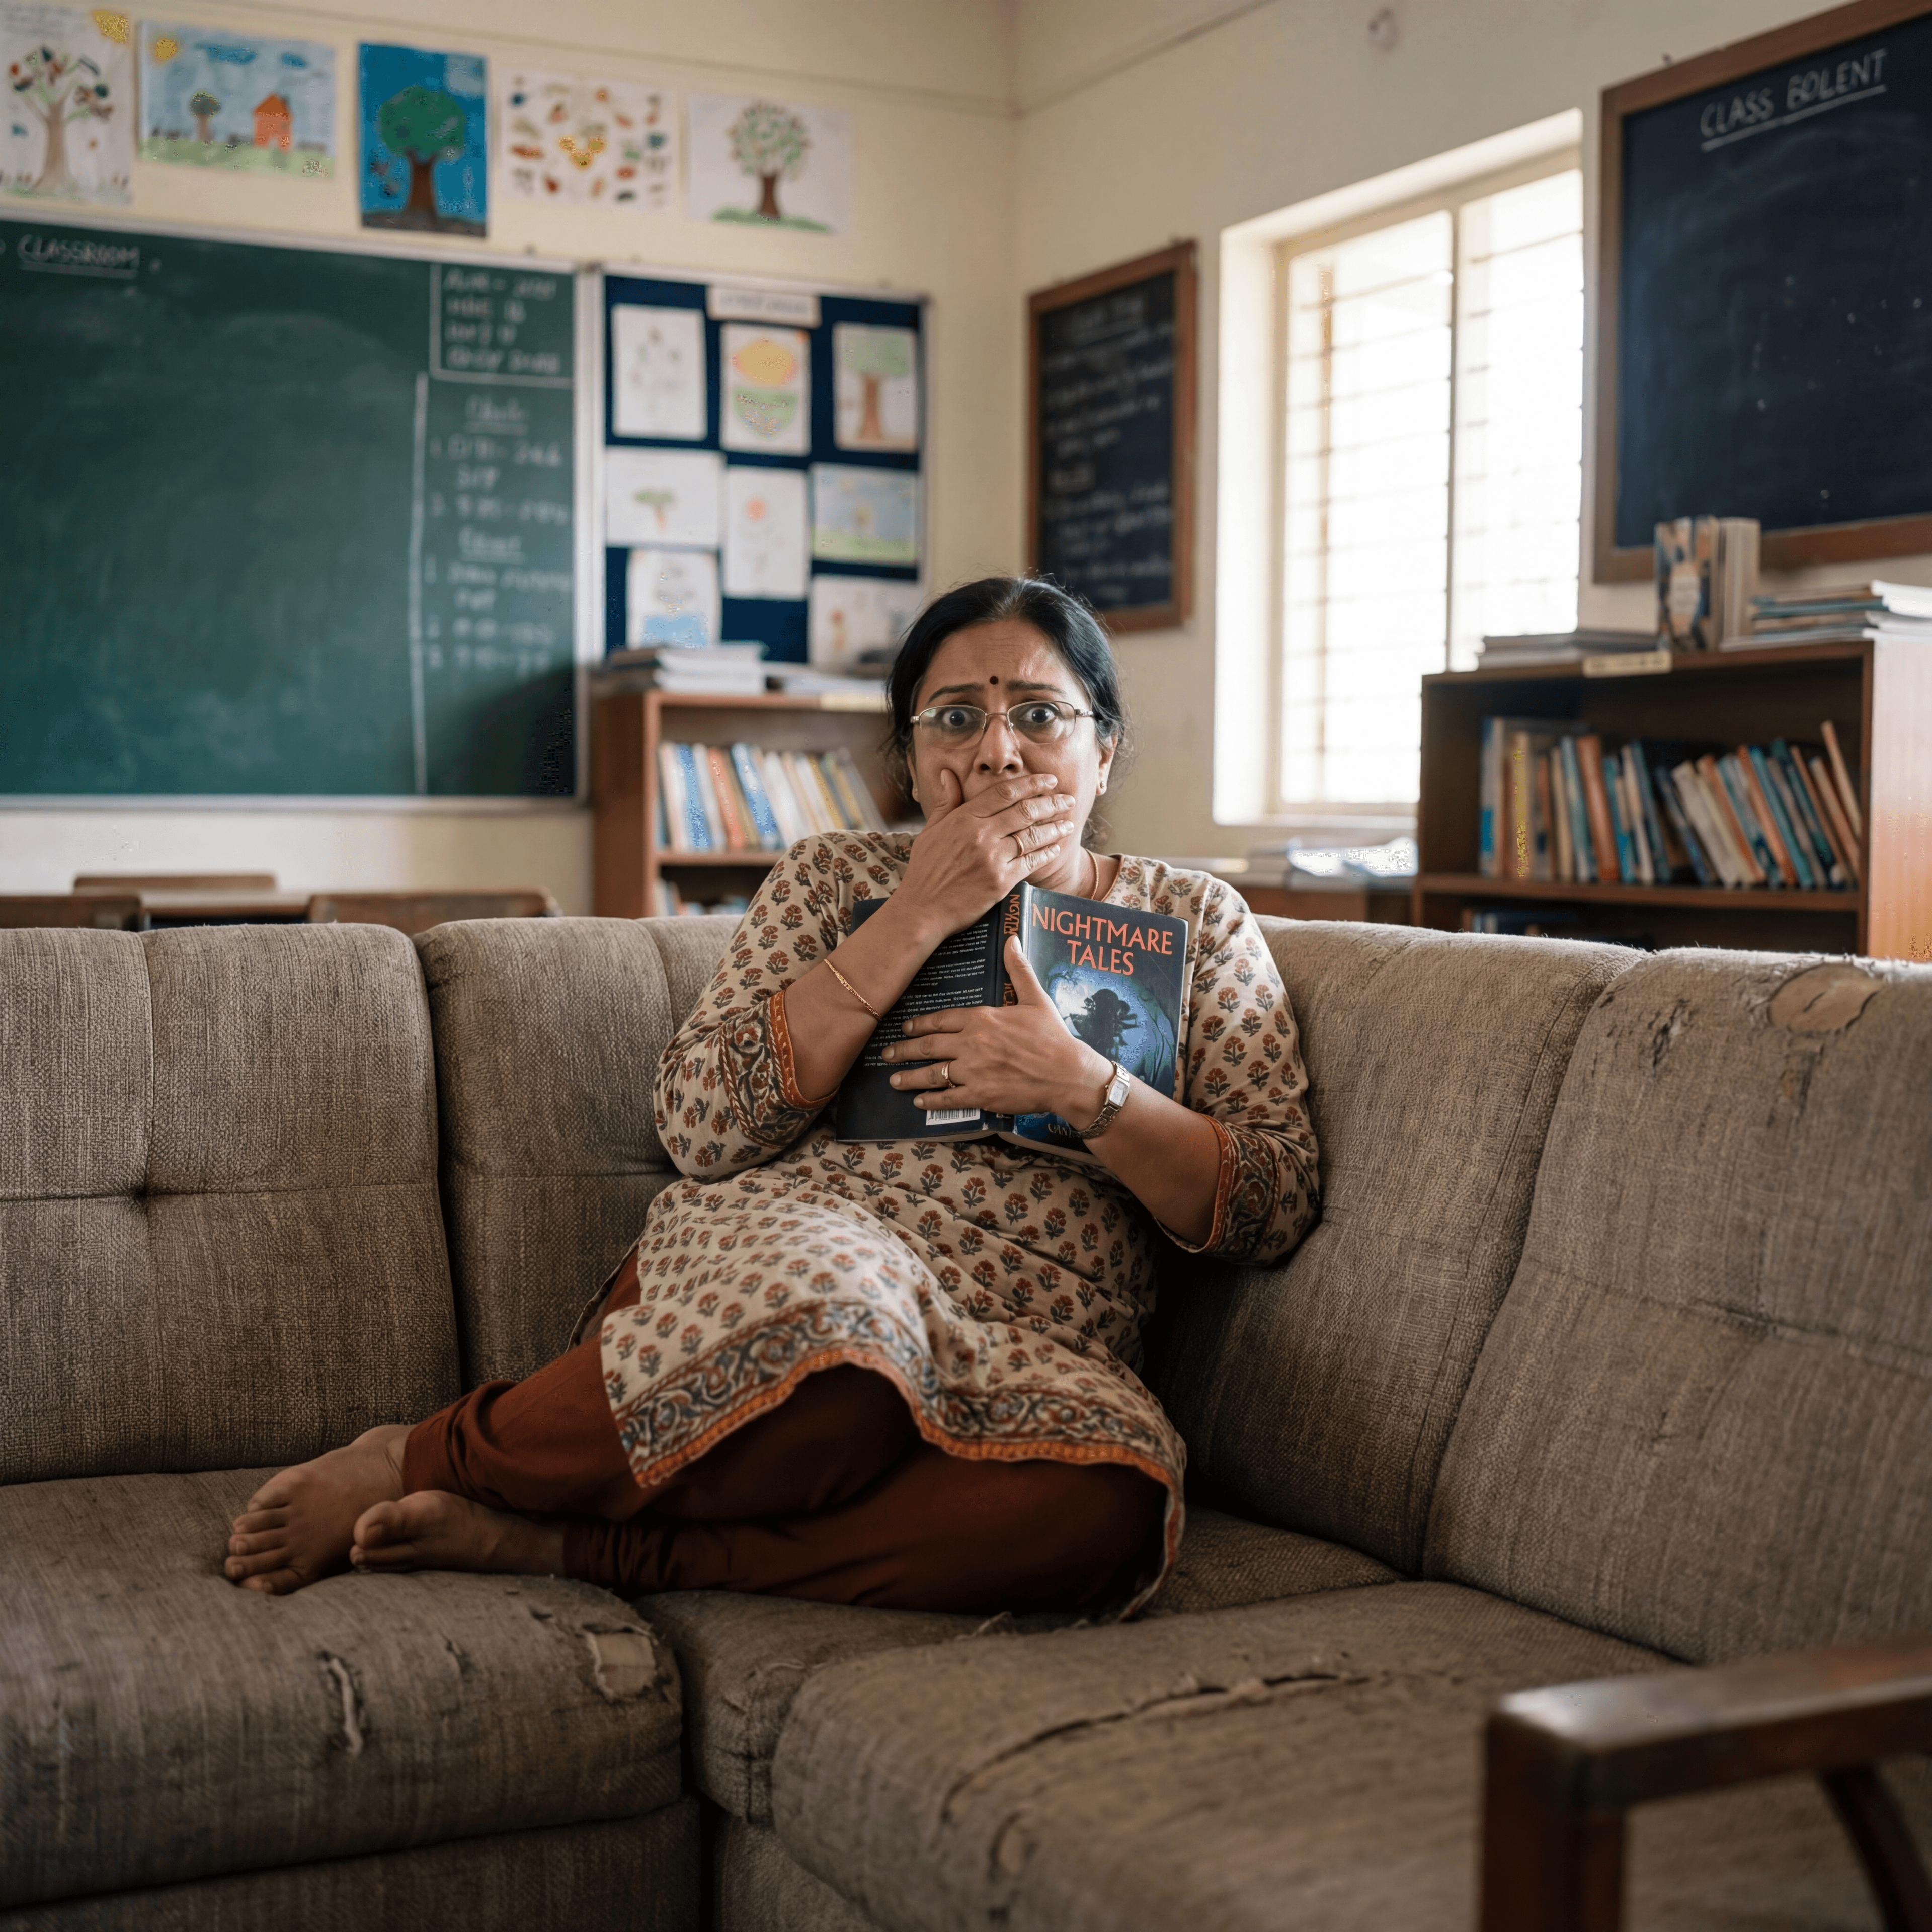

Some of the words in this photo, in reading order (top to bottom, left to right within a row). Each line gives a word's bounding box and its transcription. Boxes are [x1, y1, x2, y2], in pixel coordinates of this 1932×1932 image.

[1701, 87, 1774, 137] CLASS
[1032, 903, 1173, 955] NIGHTMARE
[1067, 939, 1134, 976] TALES
